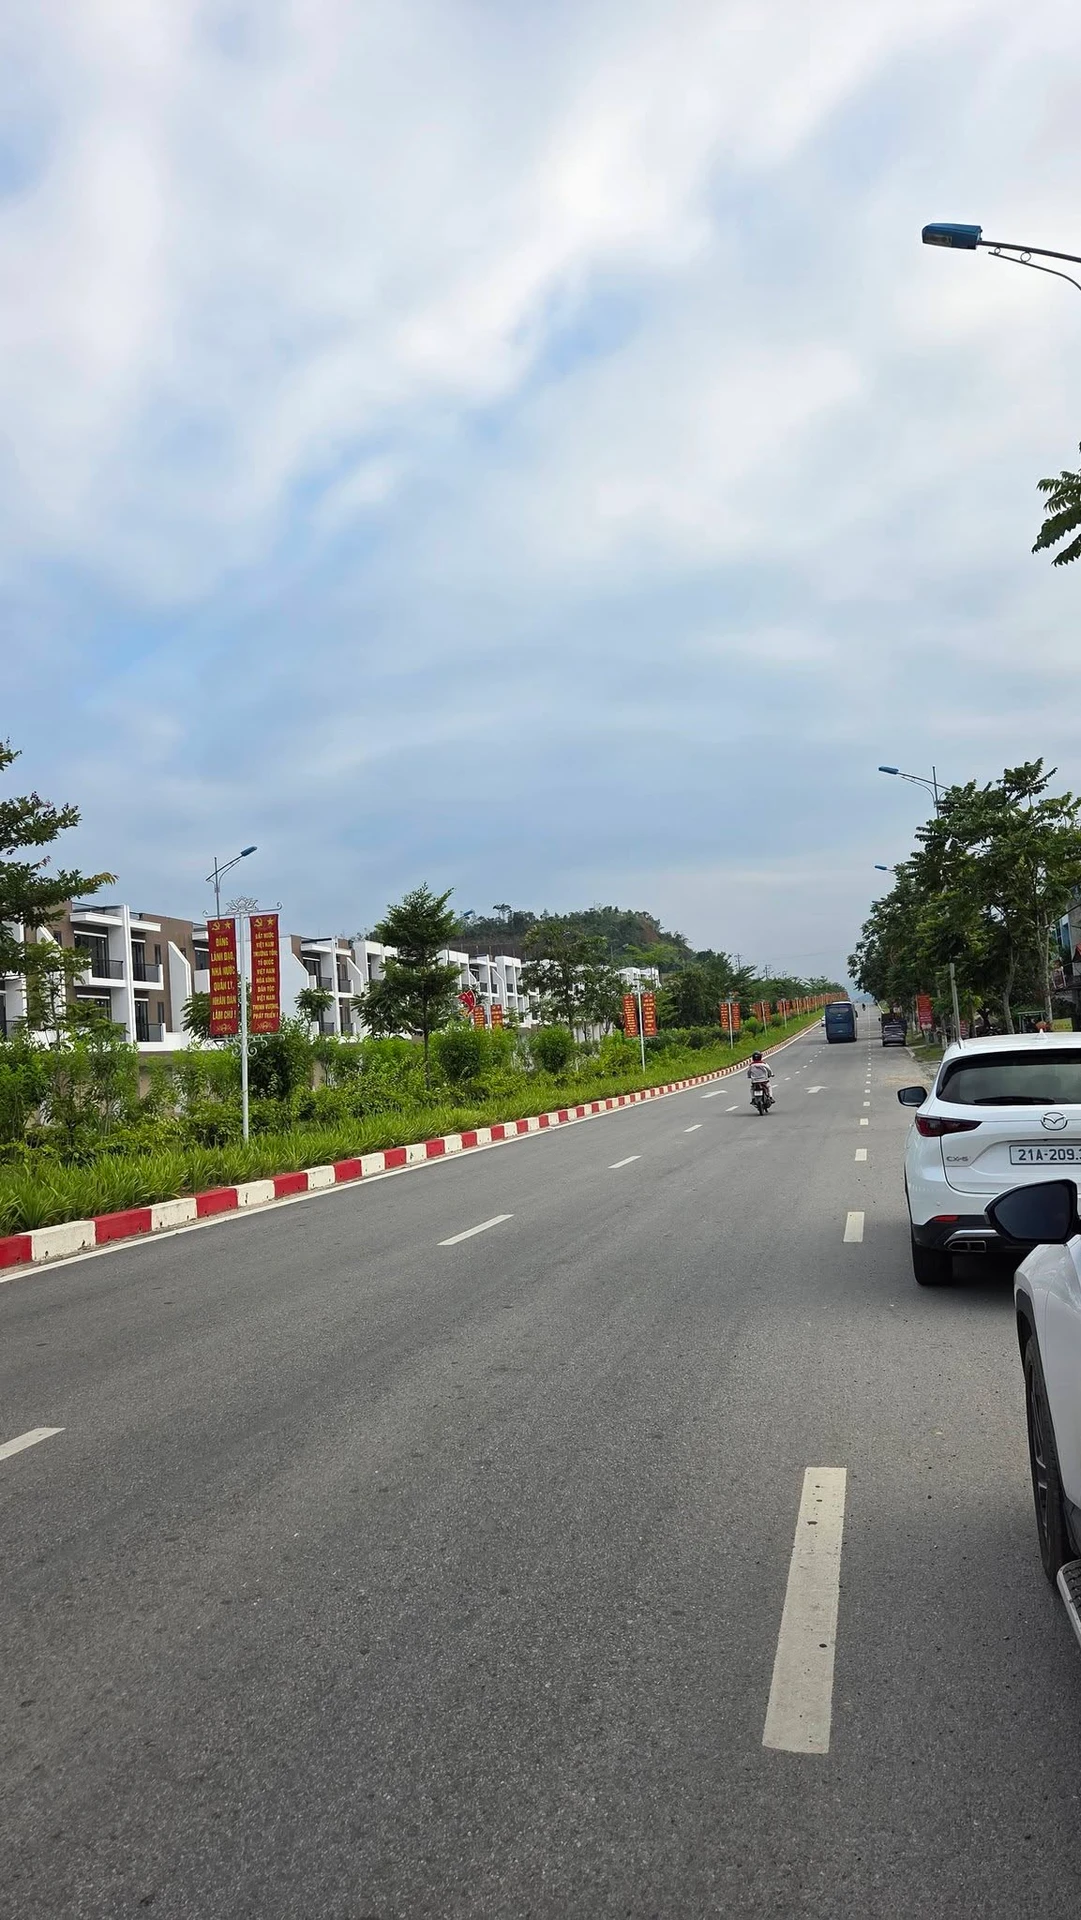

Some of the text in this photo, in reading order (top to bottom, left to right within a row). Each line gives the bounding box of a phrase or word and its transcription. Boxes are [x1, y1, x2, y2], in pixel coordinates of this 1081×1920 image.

[216, 935, 228, 946] ĐẢNG
[213, 1010, 223, 1020] LÀM
[1018, 1148, 1081, 1161] 21A-209.
